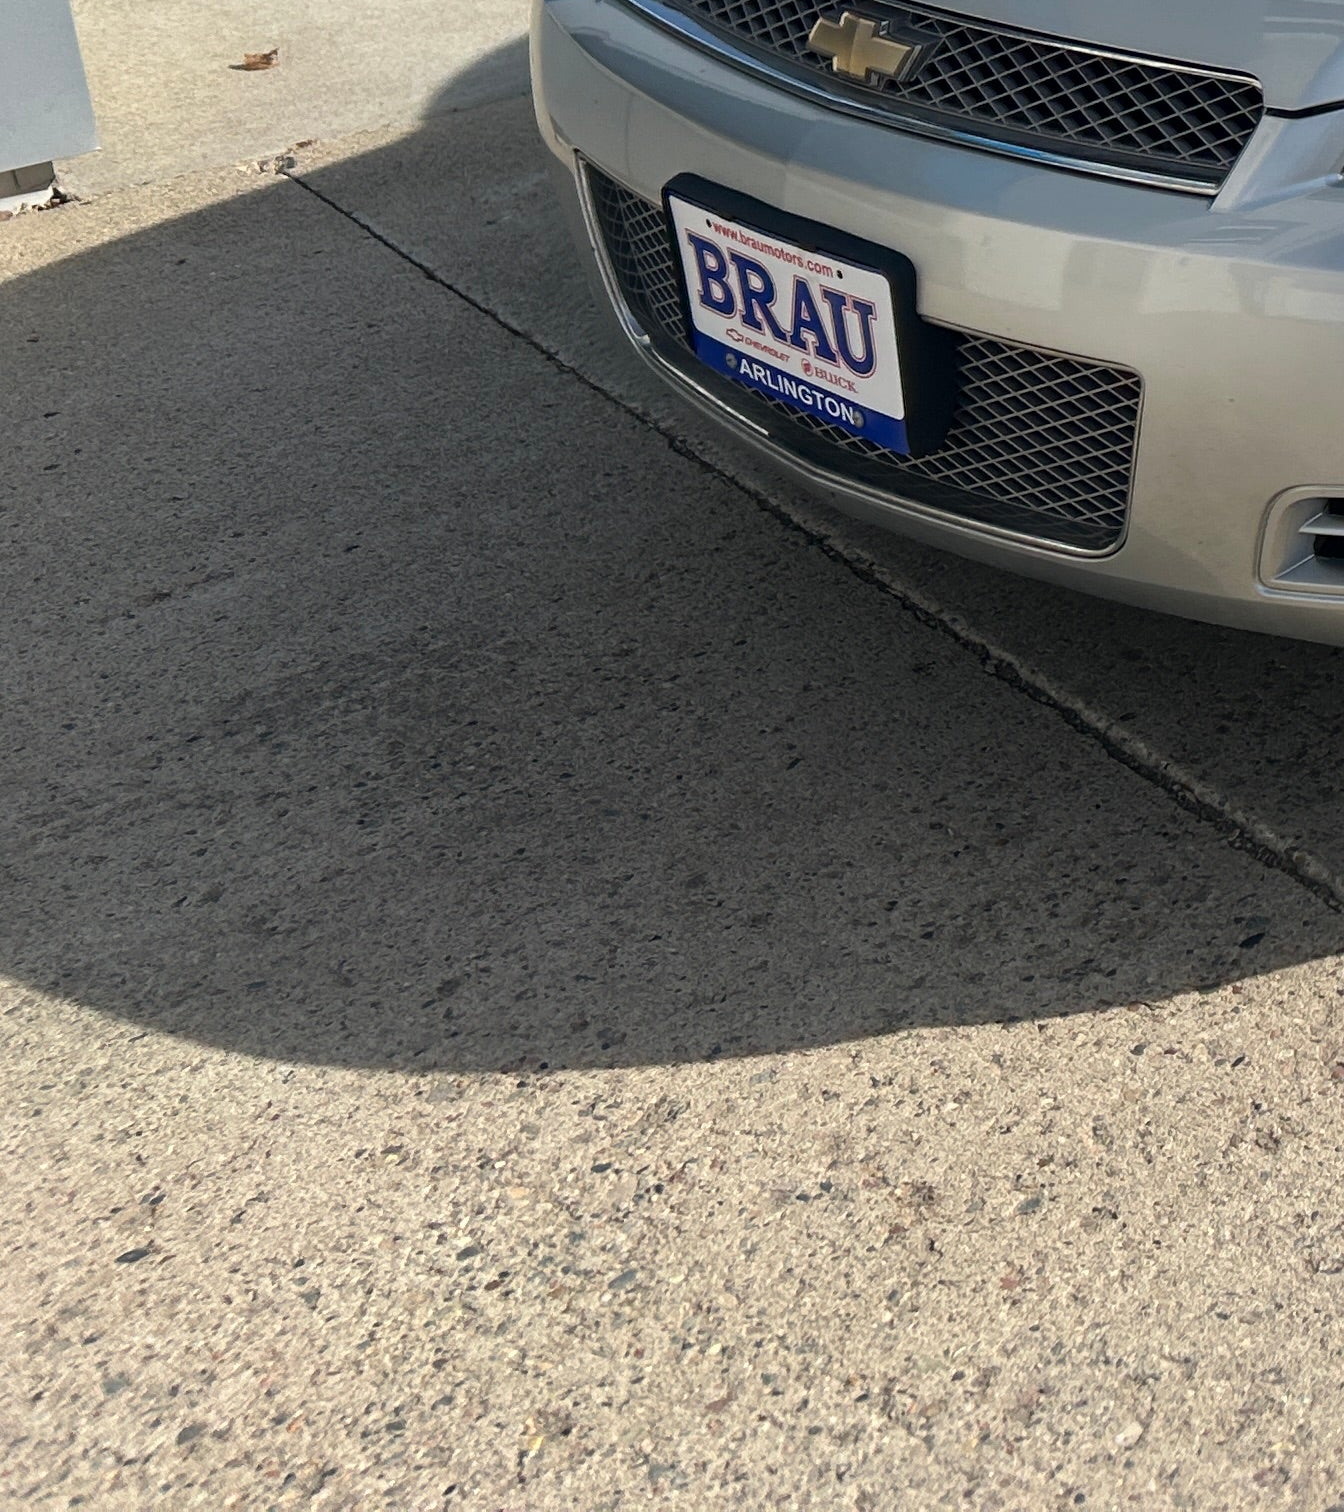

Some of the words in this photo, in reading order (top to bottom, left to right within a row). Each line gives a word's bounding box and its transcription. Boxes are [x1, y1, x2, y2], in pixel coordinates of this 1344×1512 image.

[711, 222, 834, 279] www.braumotors.com
[685, 228, 878, 380] BRAU
[744, 337, 791, 363] CHEVROLET
[739, 358, 855, 426] ARLINGTON
[815, 367, 859, 394] BUICK
